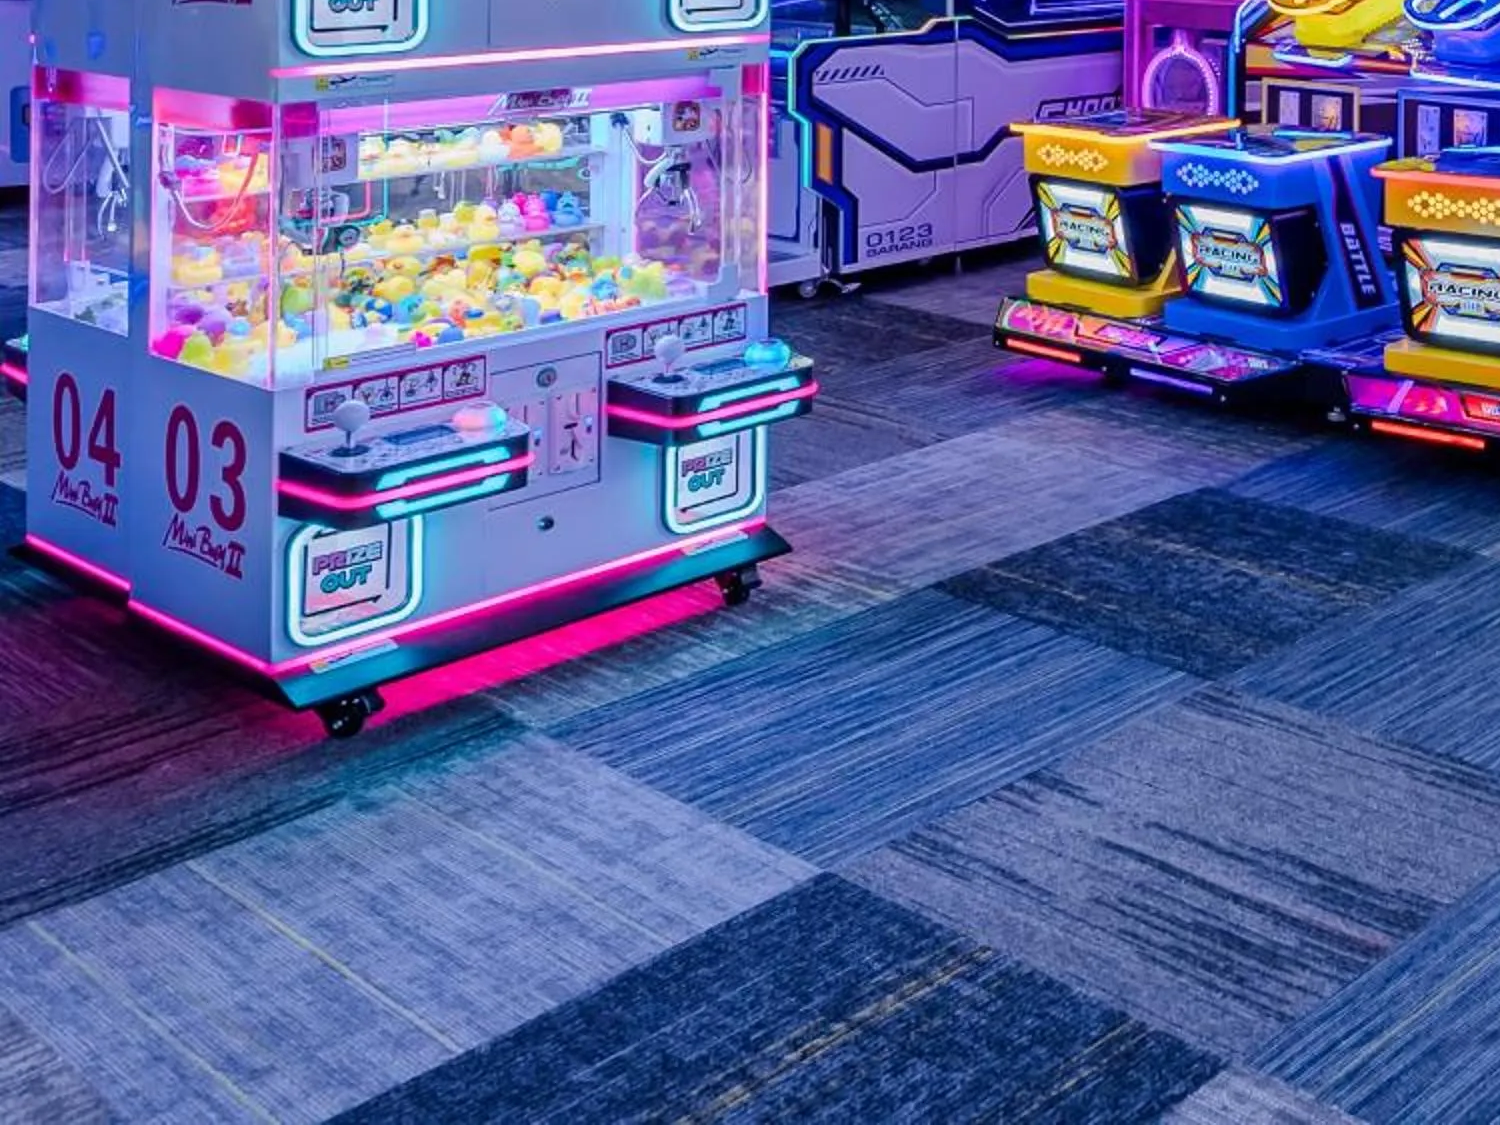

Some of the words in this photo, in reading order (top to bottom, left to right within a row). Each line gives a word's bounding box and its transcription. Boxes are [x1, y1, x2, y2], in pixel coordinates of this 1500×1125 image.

[866, 223, 933, 248] 0123
[1340, 222, 1377, 295] BATTLE
[53, 372, 121, 488] 04
[165, 404, 247, 532] 03
[312, 540, 383, 576] PRIZE
[320, 563, 373, 594] OUT
